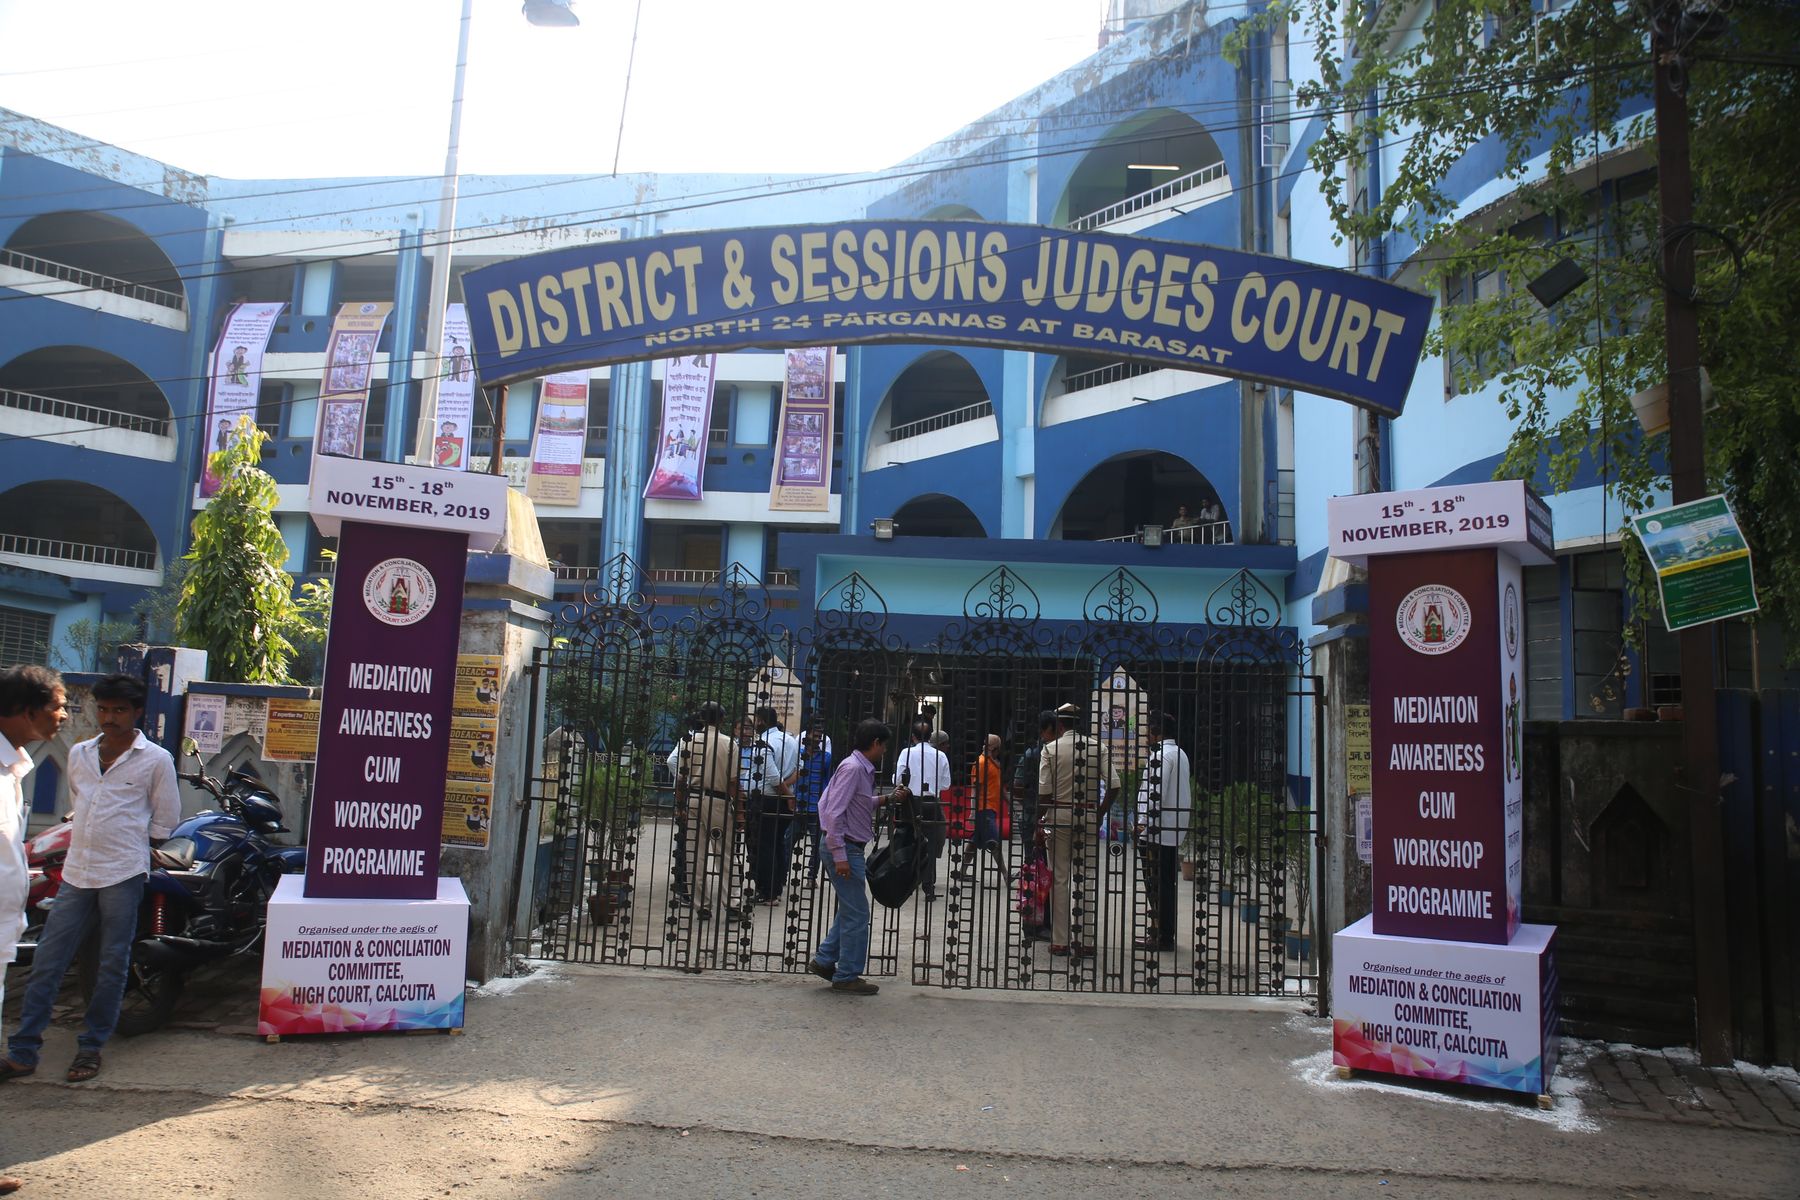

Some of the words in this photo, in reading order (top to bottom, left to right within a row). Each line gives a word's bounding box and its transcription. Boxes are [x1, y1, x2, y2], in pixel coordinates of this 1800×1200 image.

[487, 245, 703, 358] DISTRICT
[722, 238, 755, 309] &
[770, 228, 1008, 306] SESSIONS
[1022, 236, 1219, 333] JUDGES
[1231, 271, 1406, 383] COURT
[645, 317, 760, 347] NORTH
[772, 314, 812, 329] 24
[823, 310, 1008, 330] PARGANAS
[1017, 317, 1058, 334] AT
[1072, 324, 1233, 364] BARASAT
[372, 475, 405, 490] 15th
[421, 480, 454, 496] 18th
[327, 490, 438, 517] NOVEMBER,
[443, 503, 490, 520] 2019
[1381, 500, 1413, 518] 15th
[1431, 495, 1465, 514] 18th
[1341, 520, 1454, 543] NOVEMBER,
[1458, 514, 1509, 532] 2019
[365, 569, 380, 597] MEDIATION
[384, 560, 423, 572] CONCILIATION
[422, 572, 434, 602] COMMITTEE
[371, 606, 382, 618] HIGH
[382, 614, 401, 623] COURT
[401, 609, 426, 623] CALCUTTA
[1399, 600, 1410, 629] MEDIATION
[1414, 587, 1454, 598] CONCILIATION
[1453, 594, 1469, 626] COMMITTEE
[1407, 637, 1418, 649] HIGH
[1418, 645, 1437, 653] COURT
[1438, 634, 1464, 652] CALCUTTA
[349, 662, 433, 694] MEDIATION
[339, 708, 433, 739] AWARENESS
[1393, 695, 1478, 724] MEDIATION
[450, 729, 482, 740] DOEACC
[365, 755, 401, 784] CUM
[1389, 743, 1485, 772] AWARENESS
[445, 793, 477, 804] DOEACC
[1418, 791, 1456, 819] CUM
[335, 801, 423, 830] WORKSHOP
[323, 847, 426, 876] PROGRAMME
[1393, 838, 1484, 869] WORKSHOP
[1388, 884, 1492, 919] PROGRAMME
[298, 925, 349, 936] Organised
[351, 926, 379, 934] under
[382, 925, 397, 934] the
[400, 925, 426, 936] aegis
[428, 924, 439, 934] of
[282, 940, 351, 959] MEDIATION
[354, 939, 365, 957] &
[368, 938, 451, 957] CONCILIATION
[328, 961, 404, 983] COMMITTEE,
[1362, 961, 1411, 975] Organised
[1414, 967, 1443, 978] under
[1445, 970, 1462, 980] the
[1464, 973, 1491, 984] aegis
[1494, 975, 1506, 984] of
[292, 986, 325, 1005] HIGH
[328, 984, 373, 1006] COURT,
[376, 983, 436, 1002] CALCUTTA
[1349, 975, 1415, 1000] MEDIATION
[1419, 984, 1429, 1001] &
[1431, 984, 1521, 1013] CONCILIATION
[1394, 1002, 1472, 1034] COMMITTEE,
[1362, 1022, 1392, 1044] HIGH
[1395, 1026, 1440, 1053] COURT,
[1443, 1034, 1508, 1059] CALCUTTA
